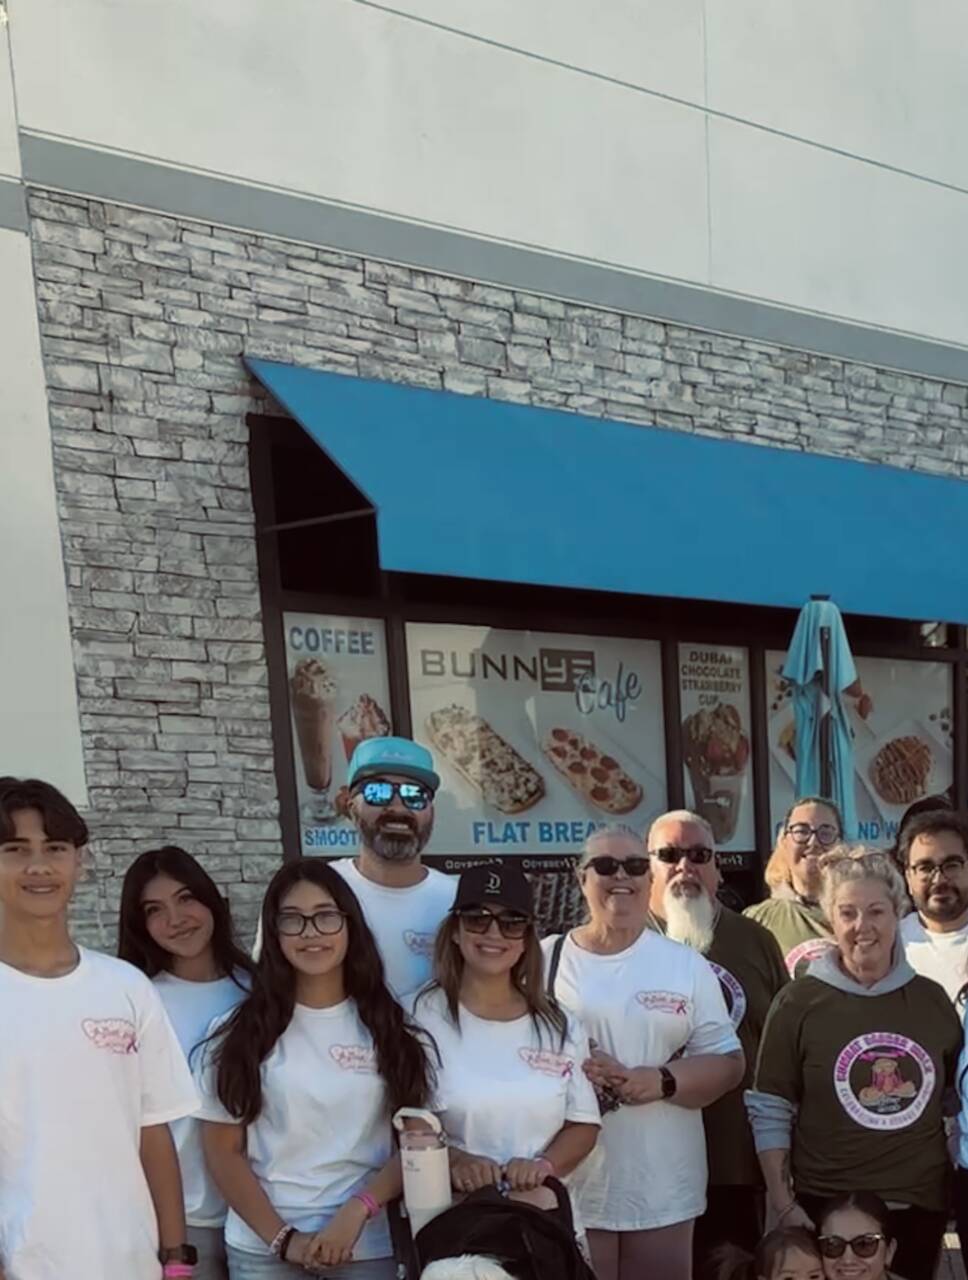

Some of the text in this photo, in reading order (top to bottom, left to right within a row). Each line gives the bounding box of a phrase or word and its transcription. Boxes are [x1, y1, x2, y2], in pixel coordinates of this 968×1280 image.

[289, 626, 375, 655] COFFEE
[681, 664, 741, 679] CHOCOLATE
[304, 829, 359, 846] SMOOT
[473, 821, 598, 843] FLAT BREA
